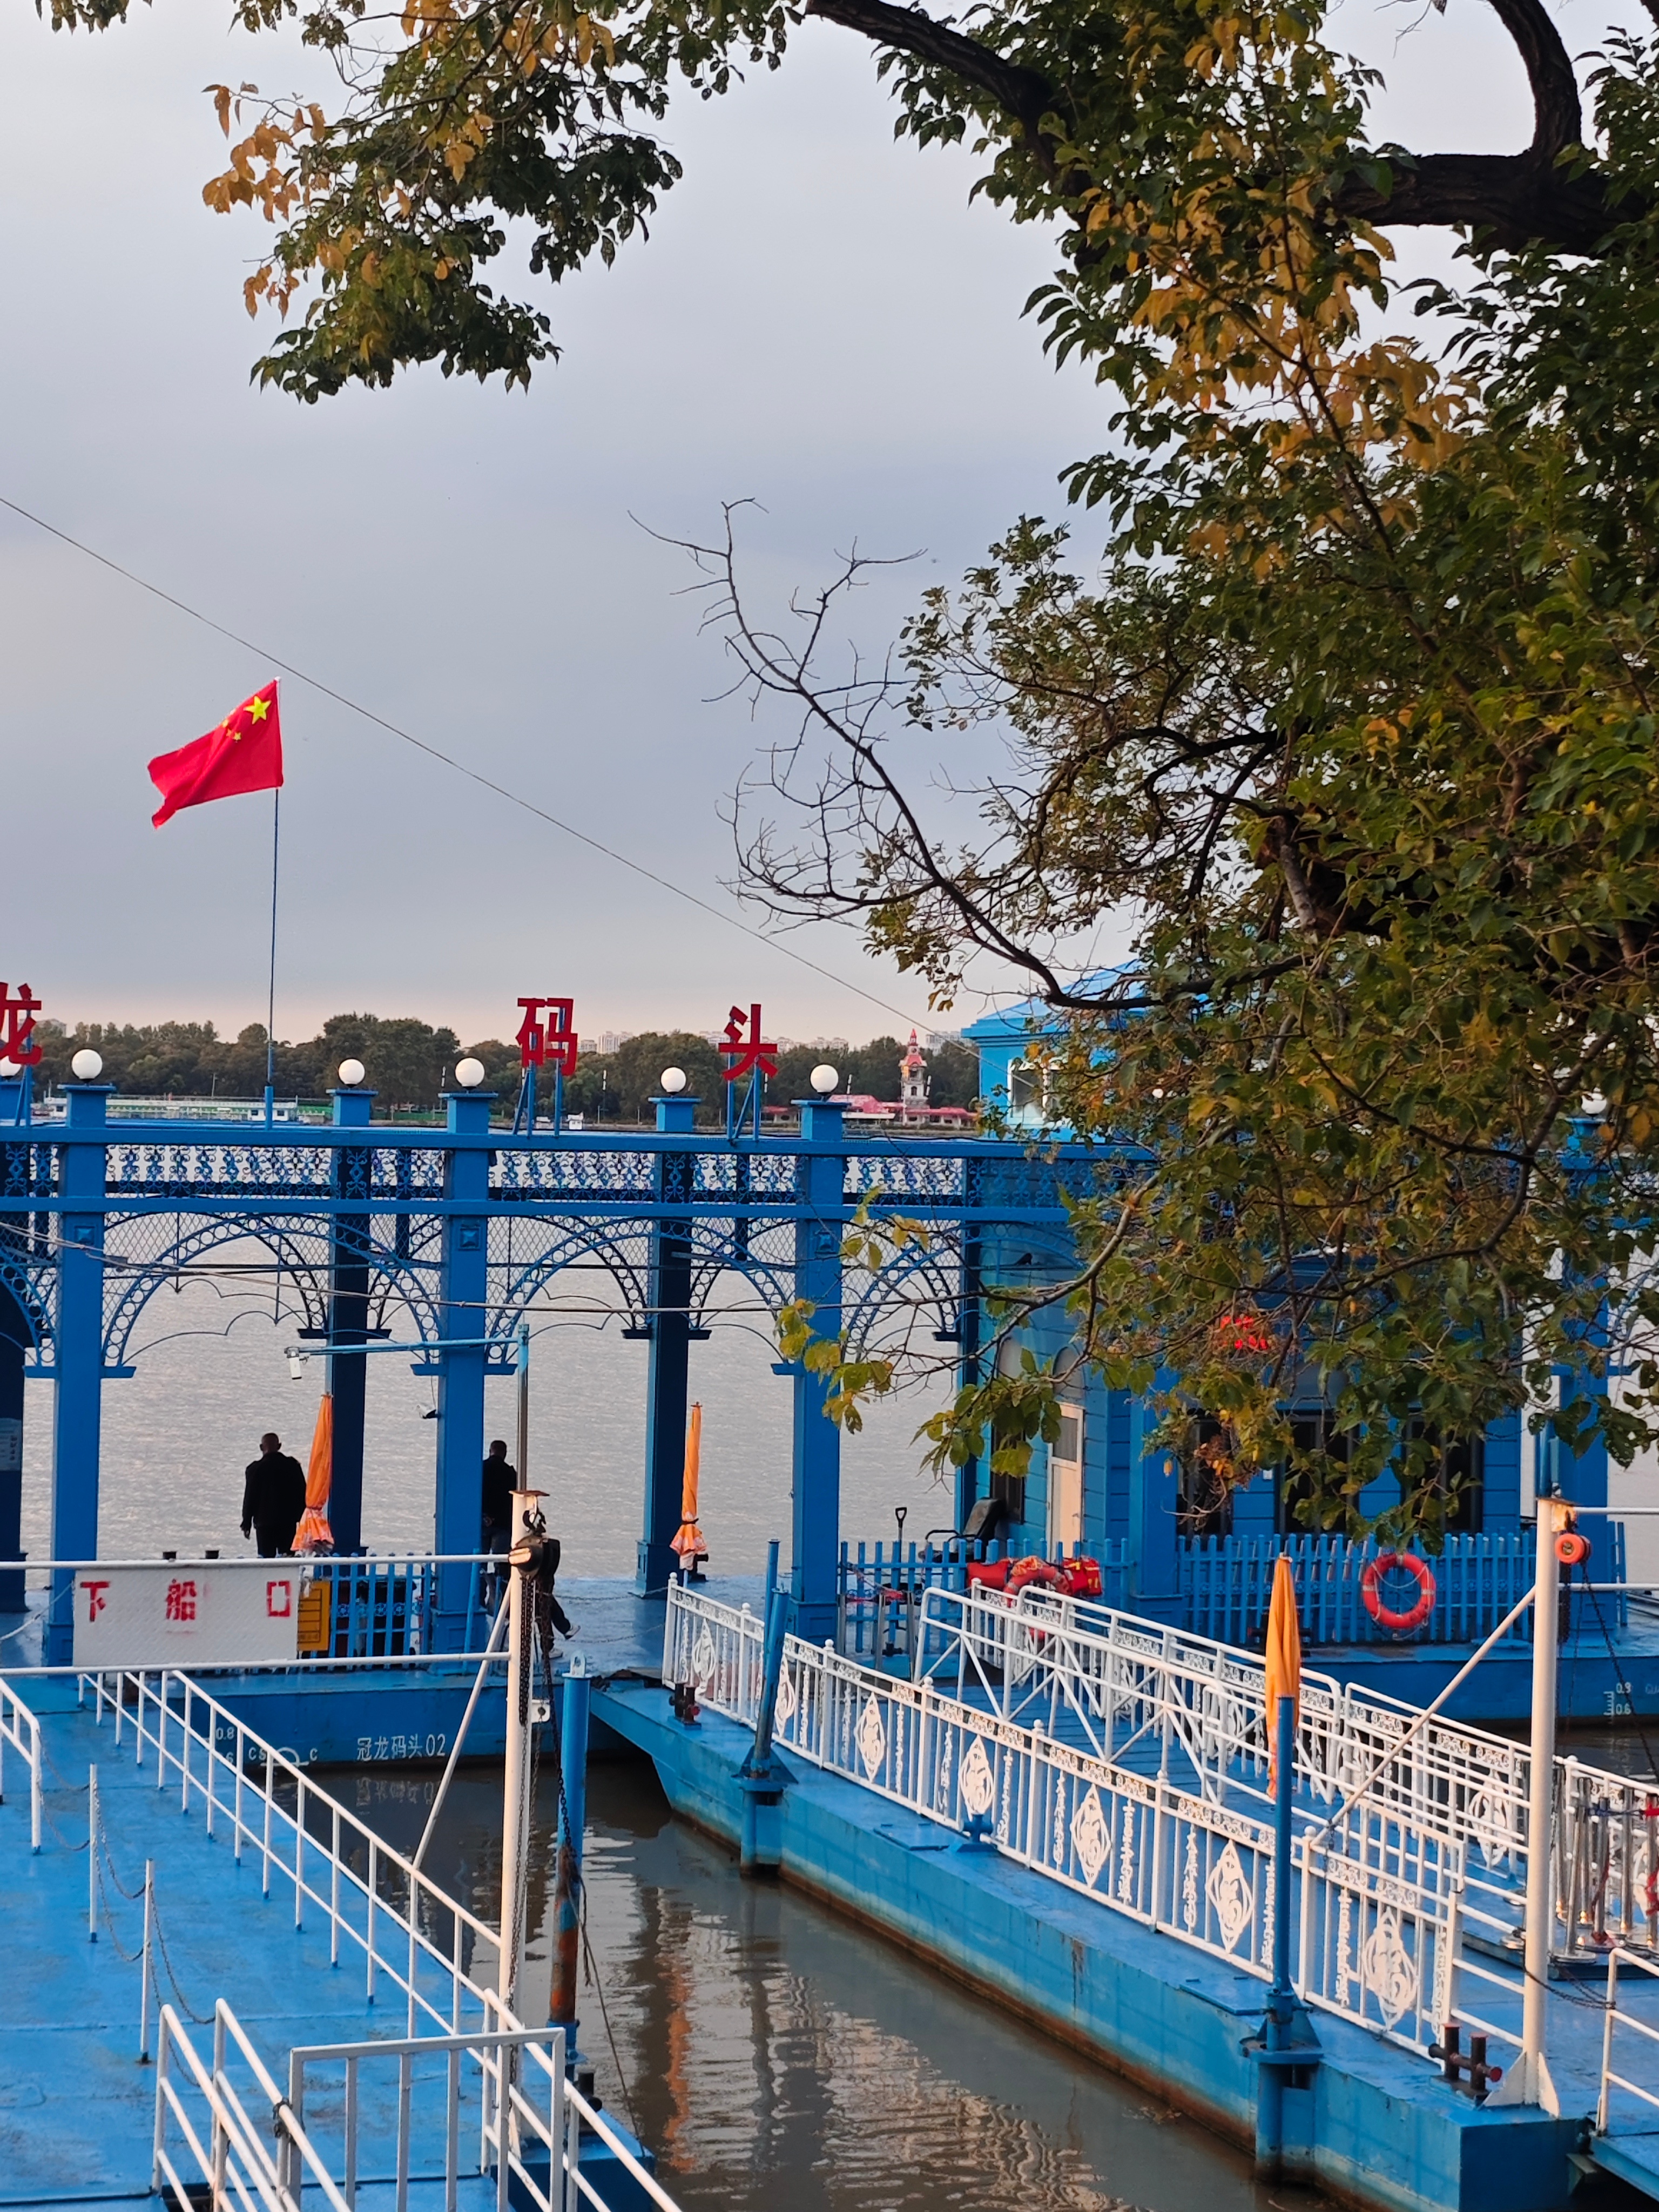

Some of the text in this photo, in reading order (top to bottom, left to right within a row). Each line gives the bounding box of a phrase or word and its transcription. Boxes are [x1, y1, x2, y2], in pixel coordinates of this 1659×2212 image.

[80, 1578, 291, 1623] 下船口
[216, 1727, 234, 1740] 0.8
[357, 1733, 446, 1761] 冠龙码头02
